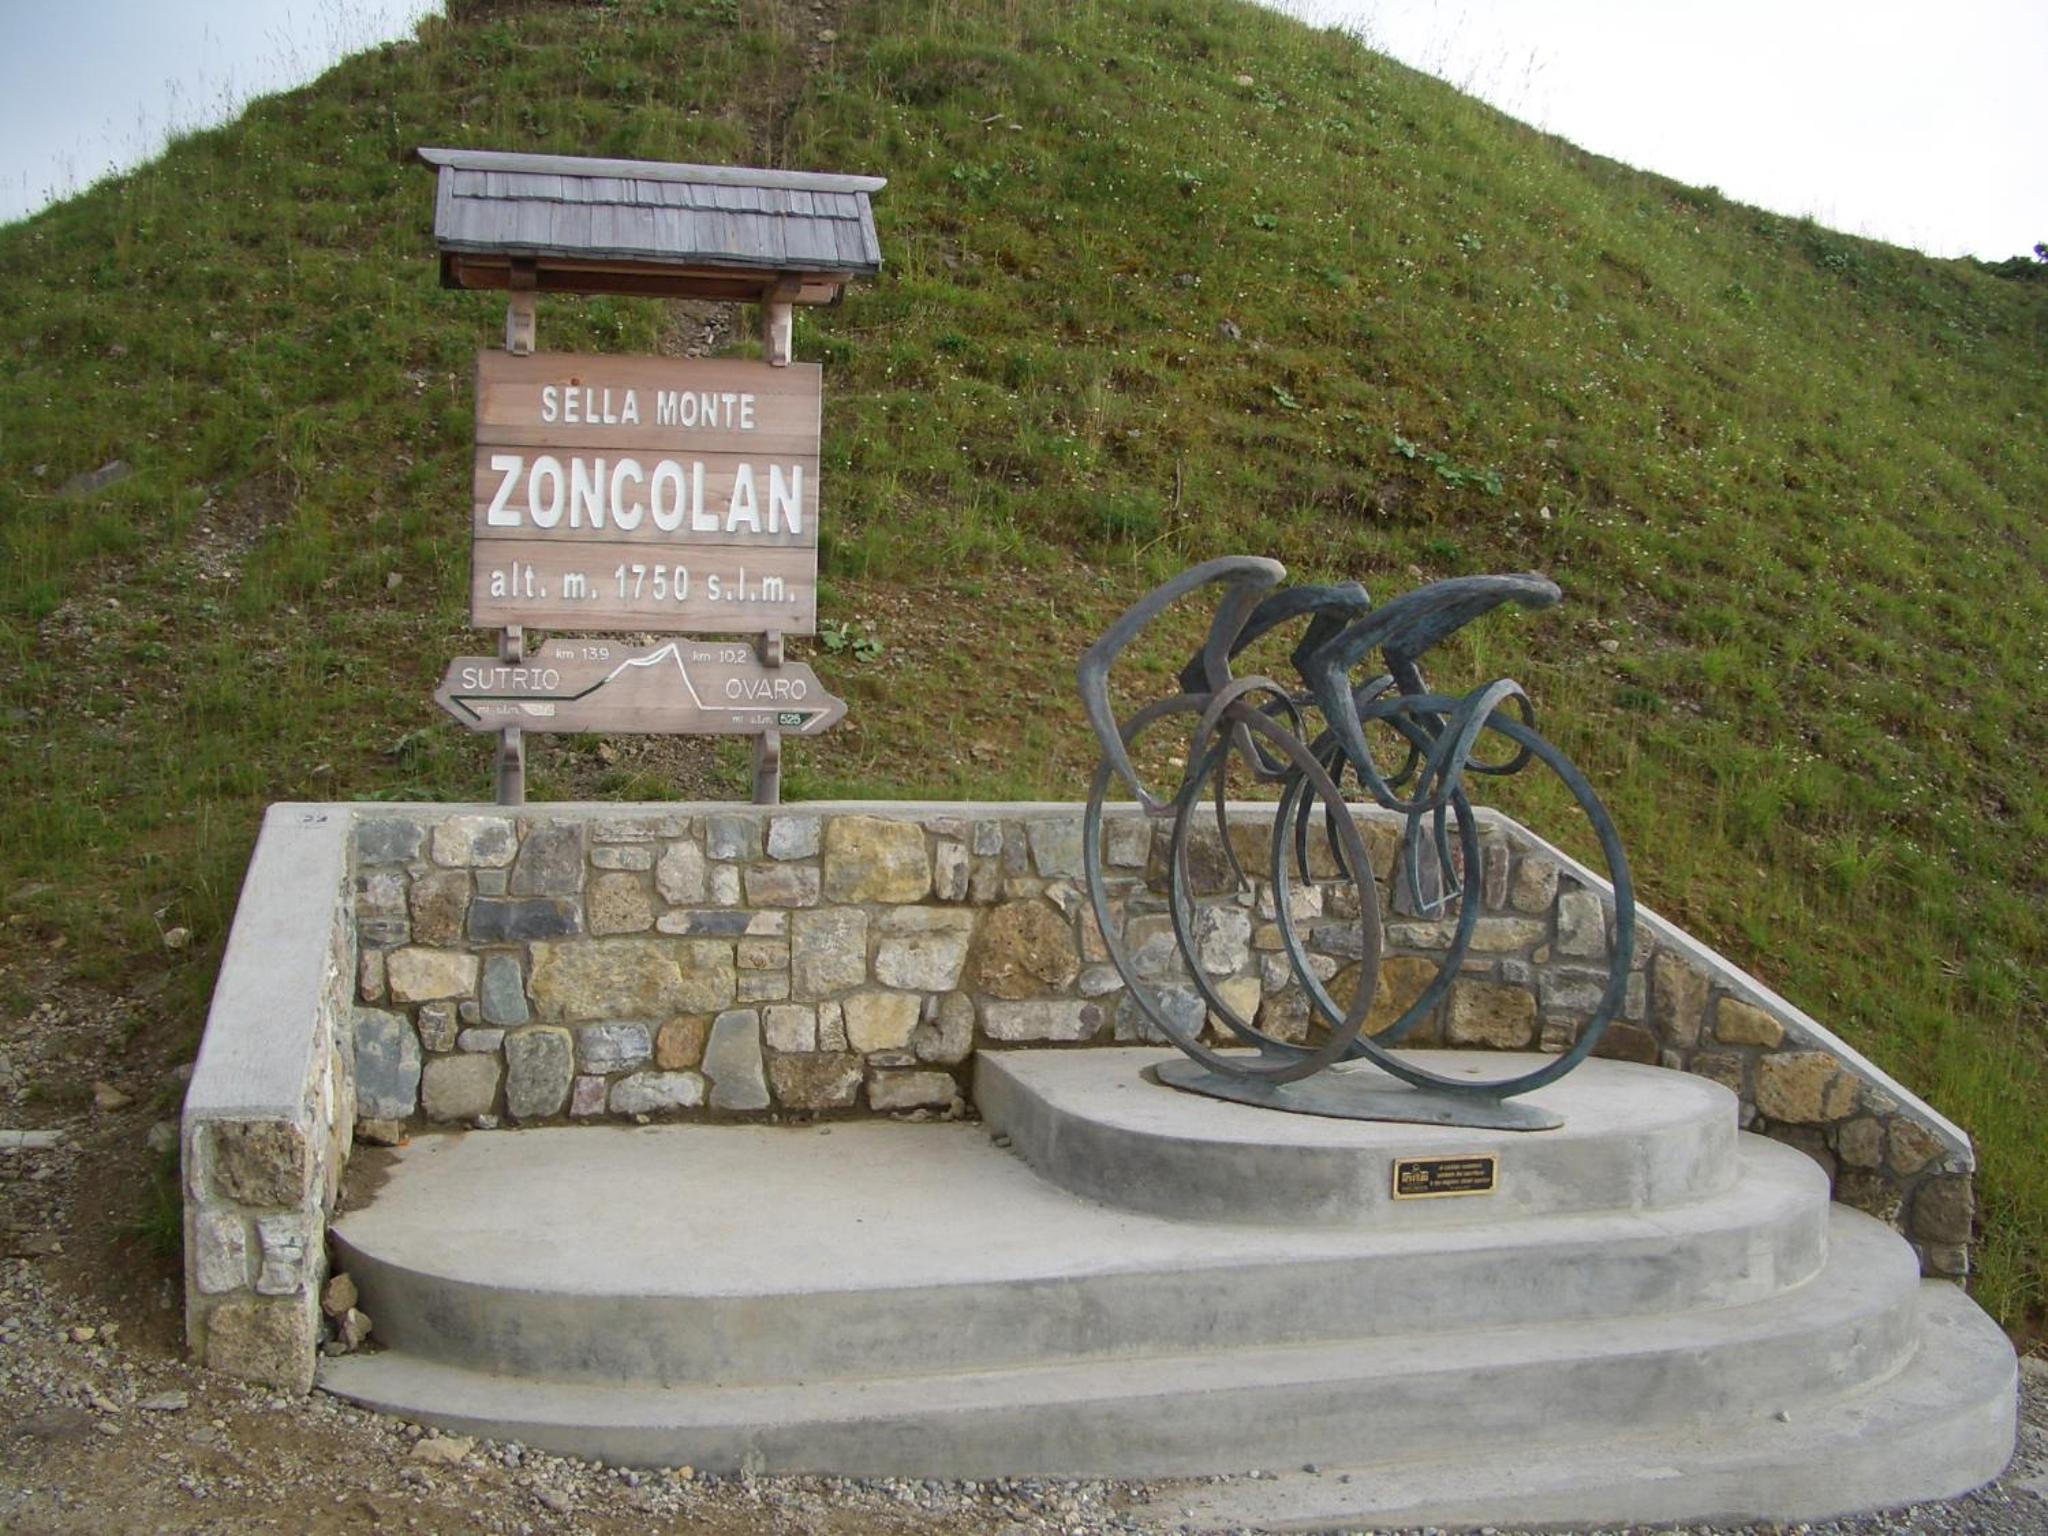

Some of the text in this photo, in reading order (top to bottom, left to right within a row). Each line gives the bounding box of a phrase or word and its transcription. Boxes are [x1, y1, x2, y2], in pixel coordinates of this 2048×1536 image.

[542, 385, 755, 429] SELLA MONTE
[487, 455, 804, 534] ZONCOLAN
[490, 561, 796, 602] alt. m. 1750 s.l.m.
[555, 648, 574, 660] km
[692, 651, 711, 663] km
[461, 667, 560, 690] SUTRIO
[725, 678, 807, 700] OVARO
[779, 713, 801, 725] 525
